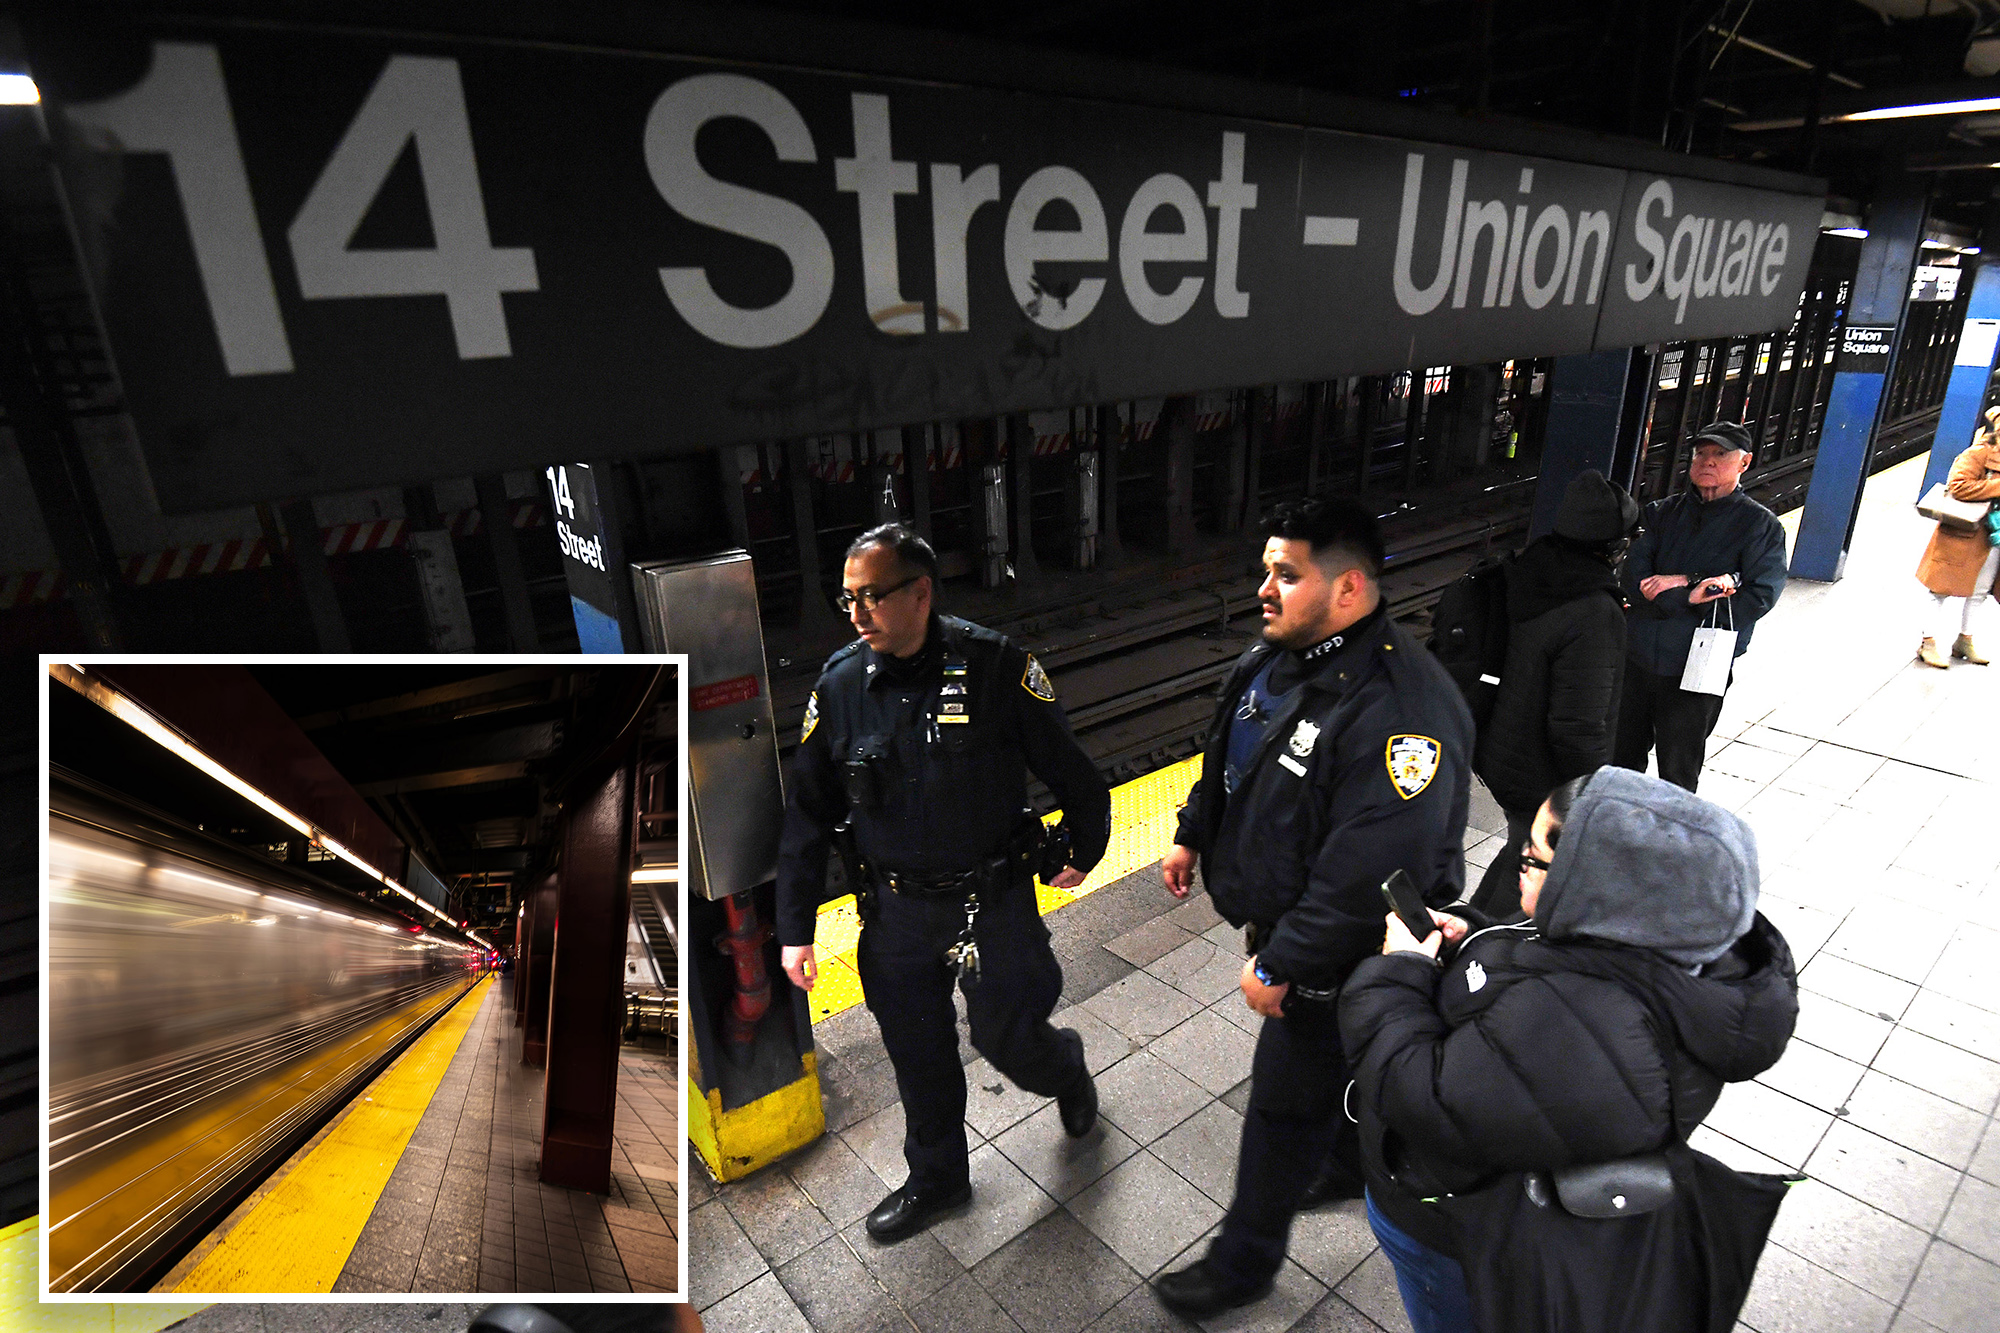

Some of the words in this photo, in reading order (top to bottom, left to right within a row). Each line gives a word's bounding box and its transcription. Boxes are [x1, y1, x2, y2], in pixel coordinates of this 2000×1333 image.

[63, 41, 540, 376] 14
[643, 73, 1259, 348] Street
[1393, 153, 1611, 316] Union
[1625, 179, 1789, 324] Square
[1842, 341, 1890, 355] Square
[1845, 329, 1882, 341] Union
[546, 465, 575, 520] 14
[556, 520, 606, 572] Street
